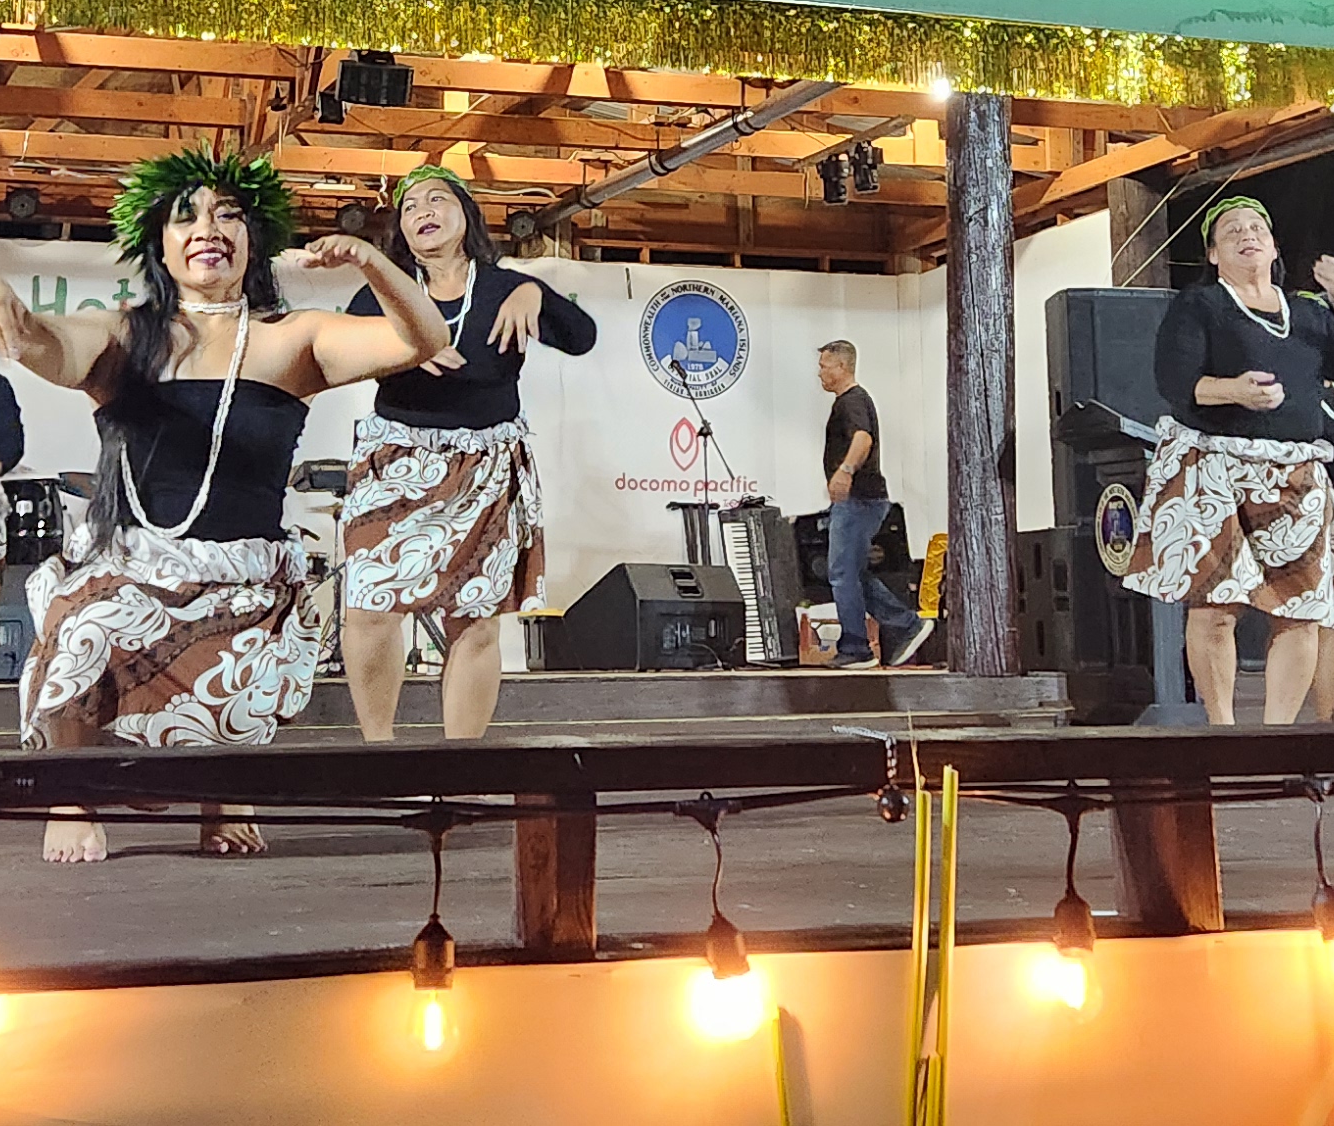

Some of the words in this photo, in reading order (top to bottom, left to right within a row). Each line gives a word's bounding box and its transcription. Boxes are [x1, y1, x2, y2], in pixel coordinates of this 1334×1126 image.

[671, 284, 716, 296] NORTHERN
[718, 295, 745, 334] MARIANA
[642, 299, 662, 372] COMMONWEALTH
[729, 338, 746, 377] ISLANDS
[615, 472, 690, 492] docomo
[694, 476, 758, 497] pacific
